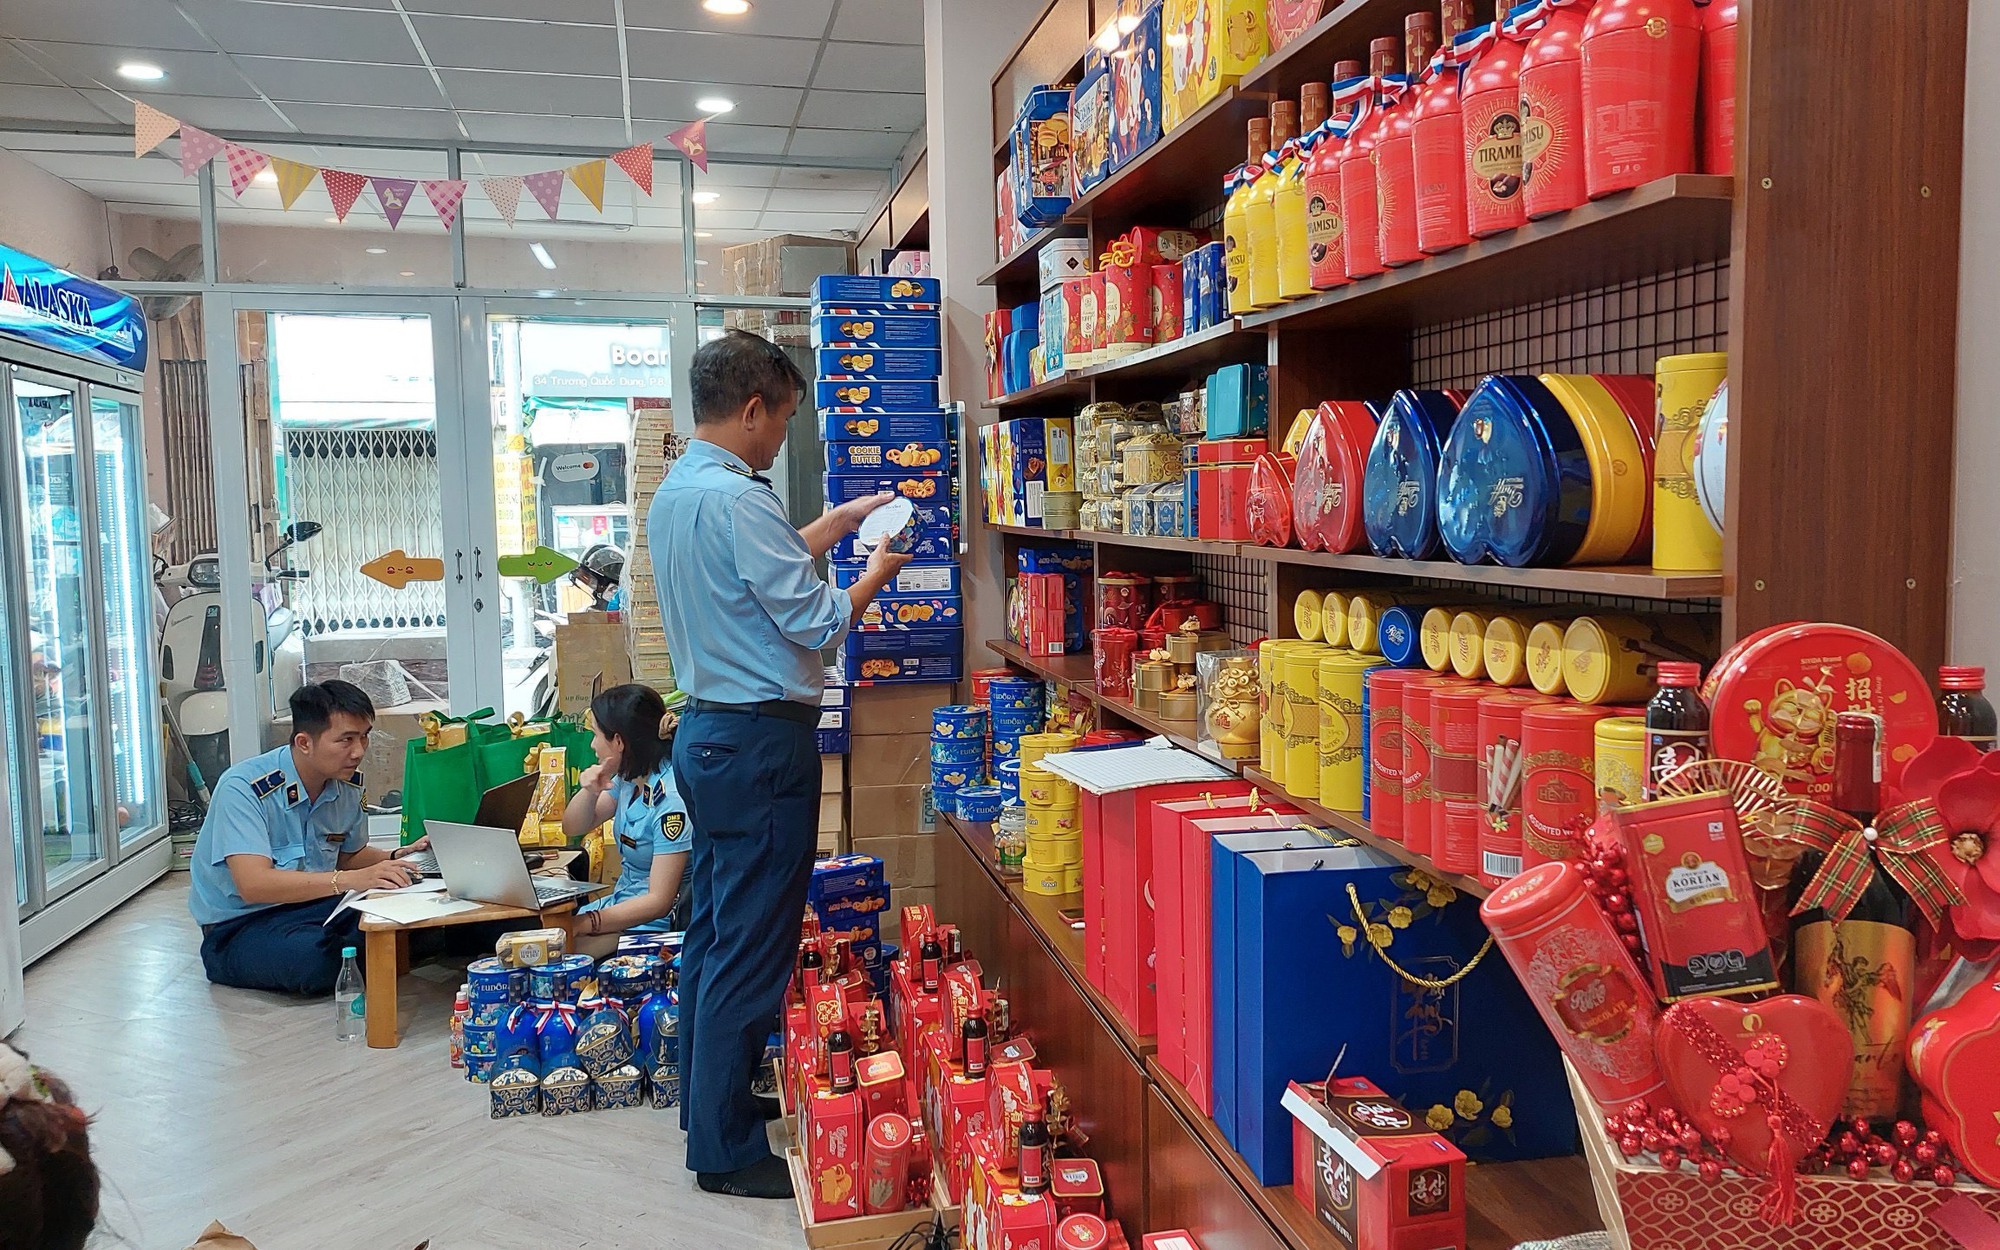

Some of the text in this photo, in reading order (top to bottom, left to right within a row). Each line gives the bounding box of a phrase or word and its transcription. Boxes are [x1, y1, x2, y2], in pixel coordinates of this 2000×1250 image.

[1478, 145, 1522, 163] TIRAMI
[24, 274, 94, 328] ALASKA
[534, 376, 547, 385] 34
[848, 445, 881, 454] COOKIE
[556, 463, 581, 471] Welcome
[850, 455, 881, 464] BUTTER
[1381, 736, 1402, 747] HEN
[1538, 787, 1577, 803] HENRY
[1528, 813, 1561, 836] ASSORTED
[1672, 873, 1720, 888] KOREAN
[1410, 1173, 1446, 1199] 홍삼
